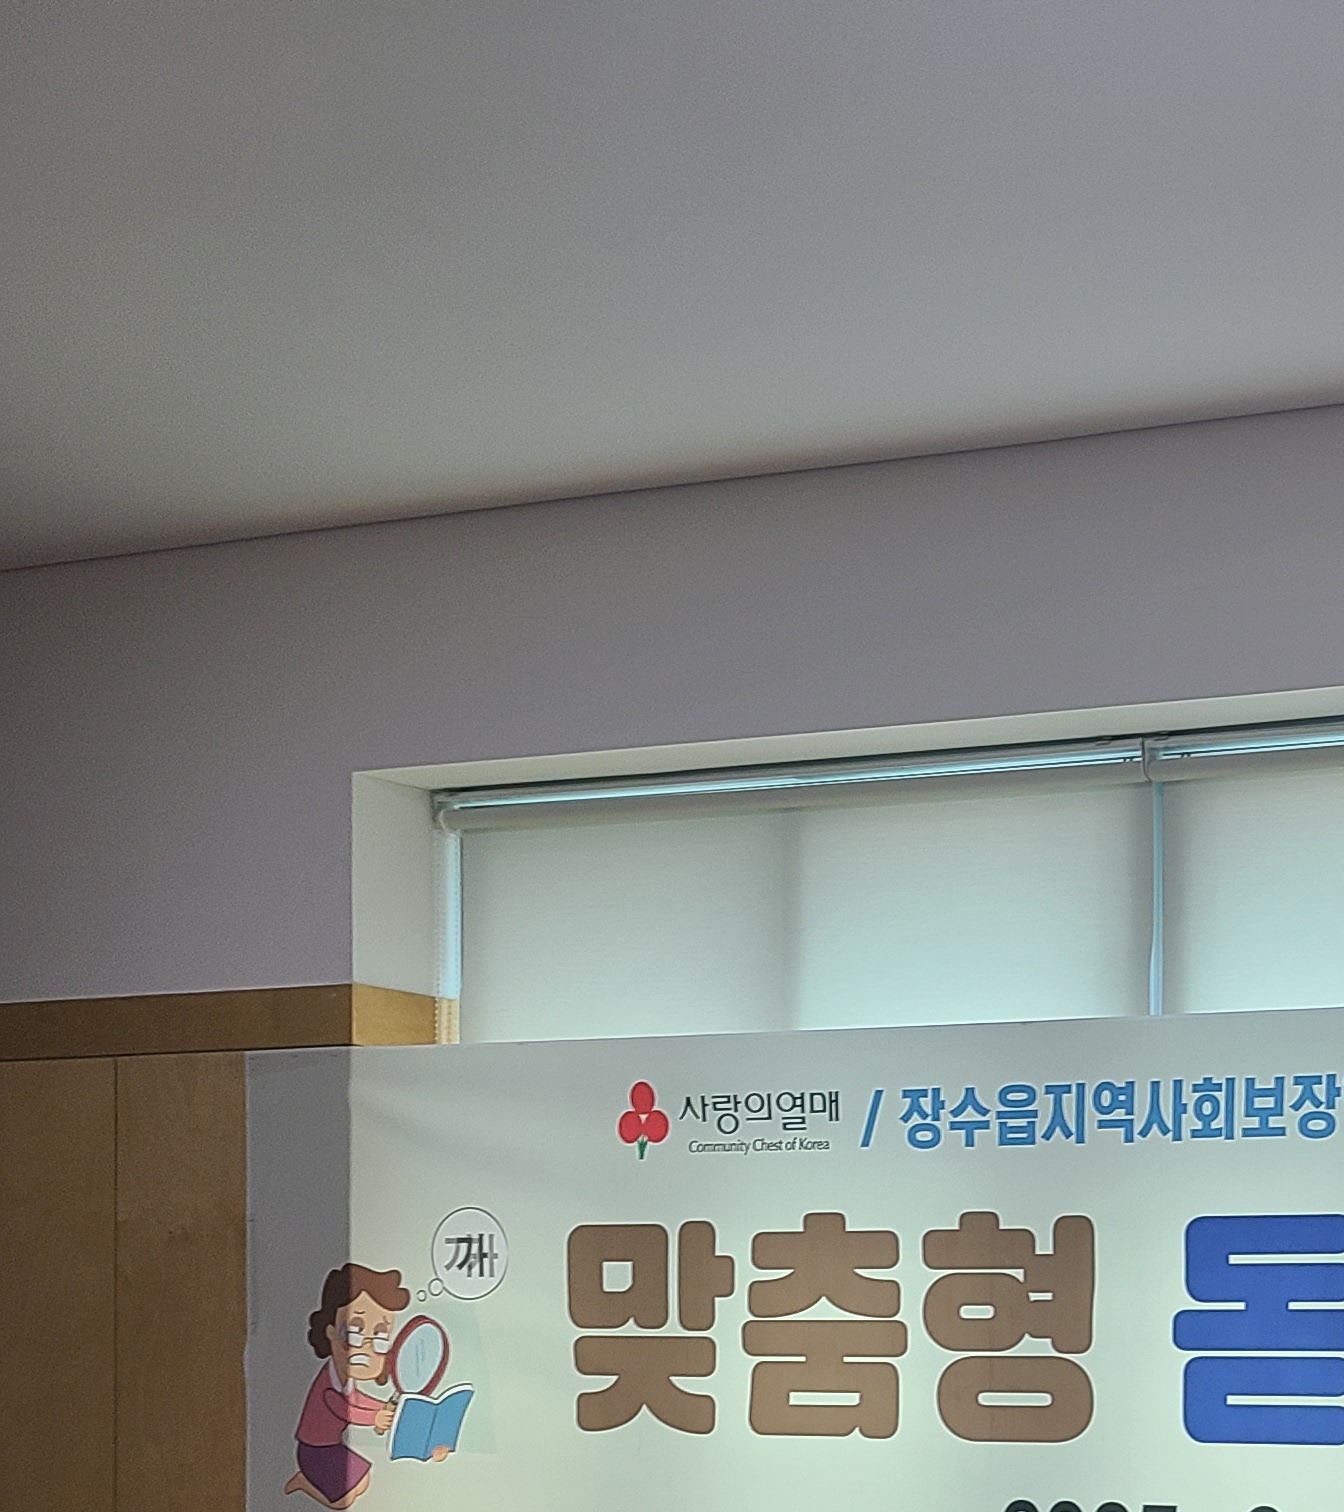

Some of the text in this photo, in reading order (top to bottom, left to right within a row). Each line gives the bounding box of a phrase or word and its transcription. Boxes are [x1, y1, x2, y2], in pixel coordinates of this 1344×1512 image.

[678, 1088, 841, 1136] 사랑의열매
[688, 1137, 830, 1156] Community Chest of Korea
[566, 1211, 1094, 1443] 맞춤형
